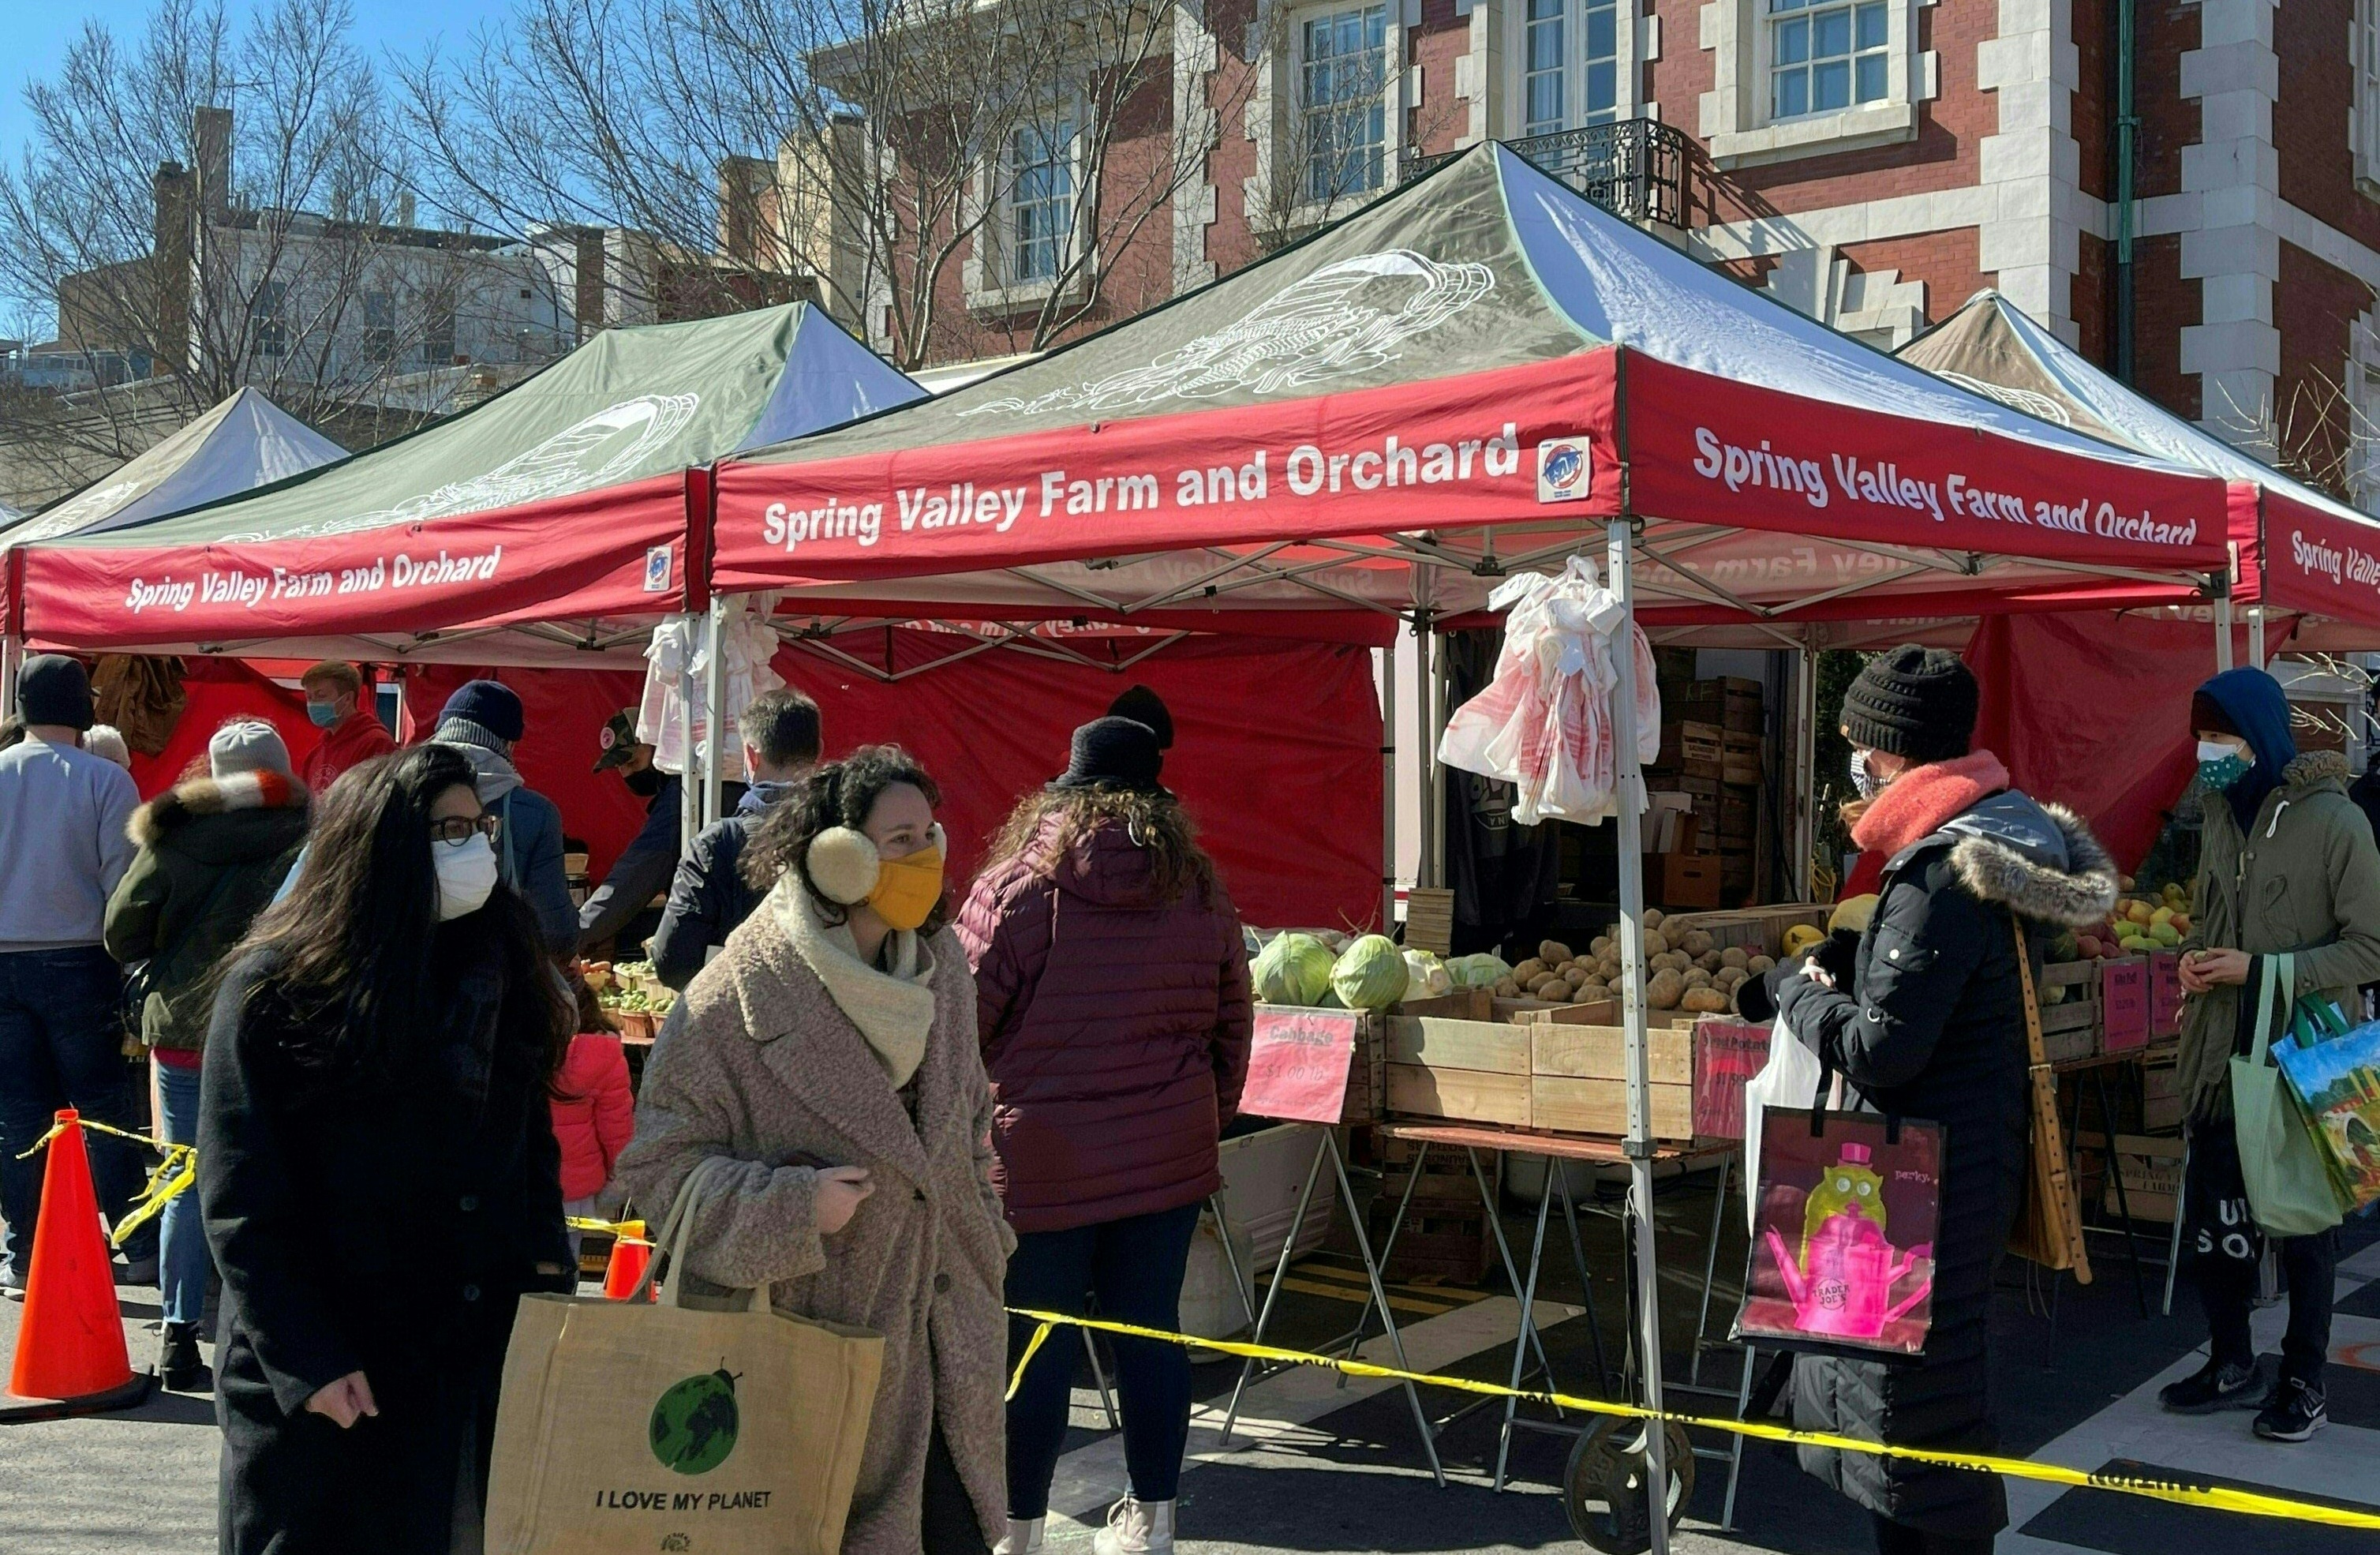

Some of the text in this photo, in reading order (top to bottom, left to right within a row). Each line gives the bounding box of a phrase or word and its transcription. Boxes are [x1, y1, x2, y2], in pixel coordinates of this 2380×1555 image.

[762, 496, 883, 552] Spring
[896, 481, 1027, 533] Valley
[1039, 470, 1159, 518] Farm
[1176, 449, 1267, 507] and
[1286, 422, 1520, 496] Orchard
[1693, 427, 2197, 545] Spring Valley Farm and Orchard
[125, 545, 503, 614] Spring Valley Farm and Orchard
[2292, 530, 2380, 594] Spring Valle
[1270, 1025, 1334, 1047] Cabbage
[1812, 1283, 1850, 1298] TRADER
[1819, 1293, 1847, 1306] JOE'S
[596, 1490, 772, 1511] I LOVE MY PLANET
